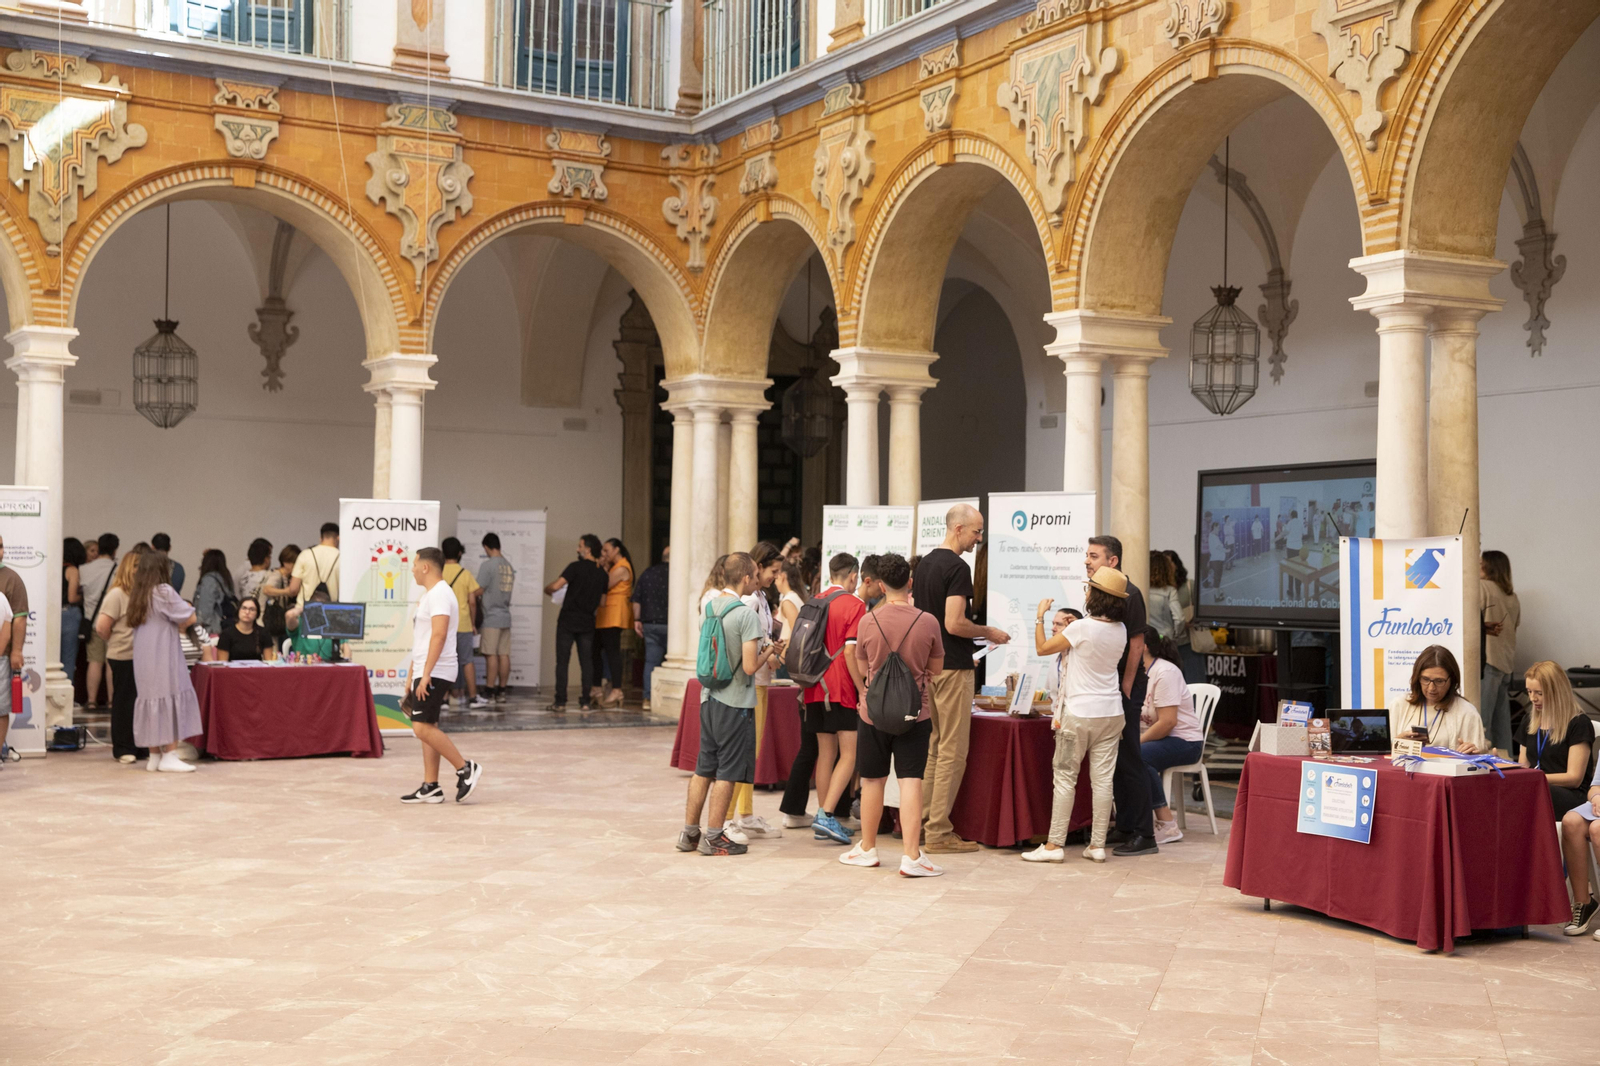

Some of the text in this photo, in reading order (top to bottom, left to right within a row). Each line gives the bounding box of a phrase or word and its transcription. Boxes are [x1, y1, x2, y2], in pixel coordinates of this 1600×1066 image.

[352, 516, 427, 531] ACOPINB
[1030, 512, 1071, 530] promi
[922, 528, 946, 538] ORIENT
[1225, 597, 1252, 606] Centro
[1254, 597, 1305, 609] Ocupacional
[1307, 598, 1318, 607] de
[1368, 608, 1453, 638] Funlabor
[1206, 656, 1246, 677] BOREA
